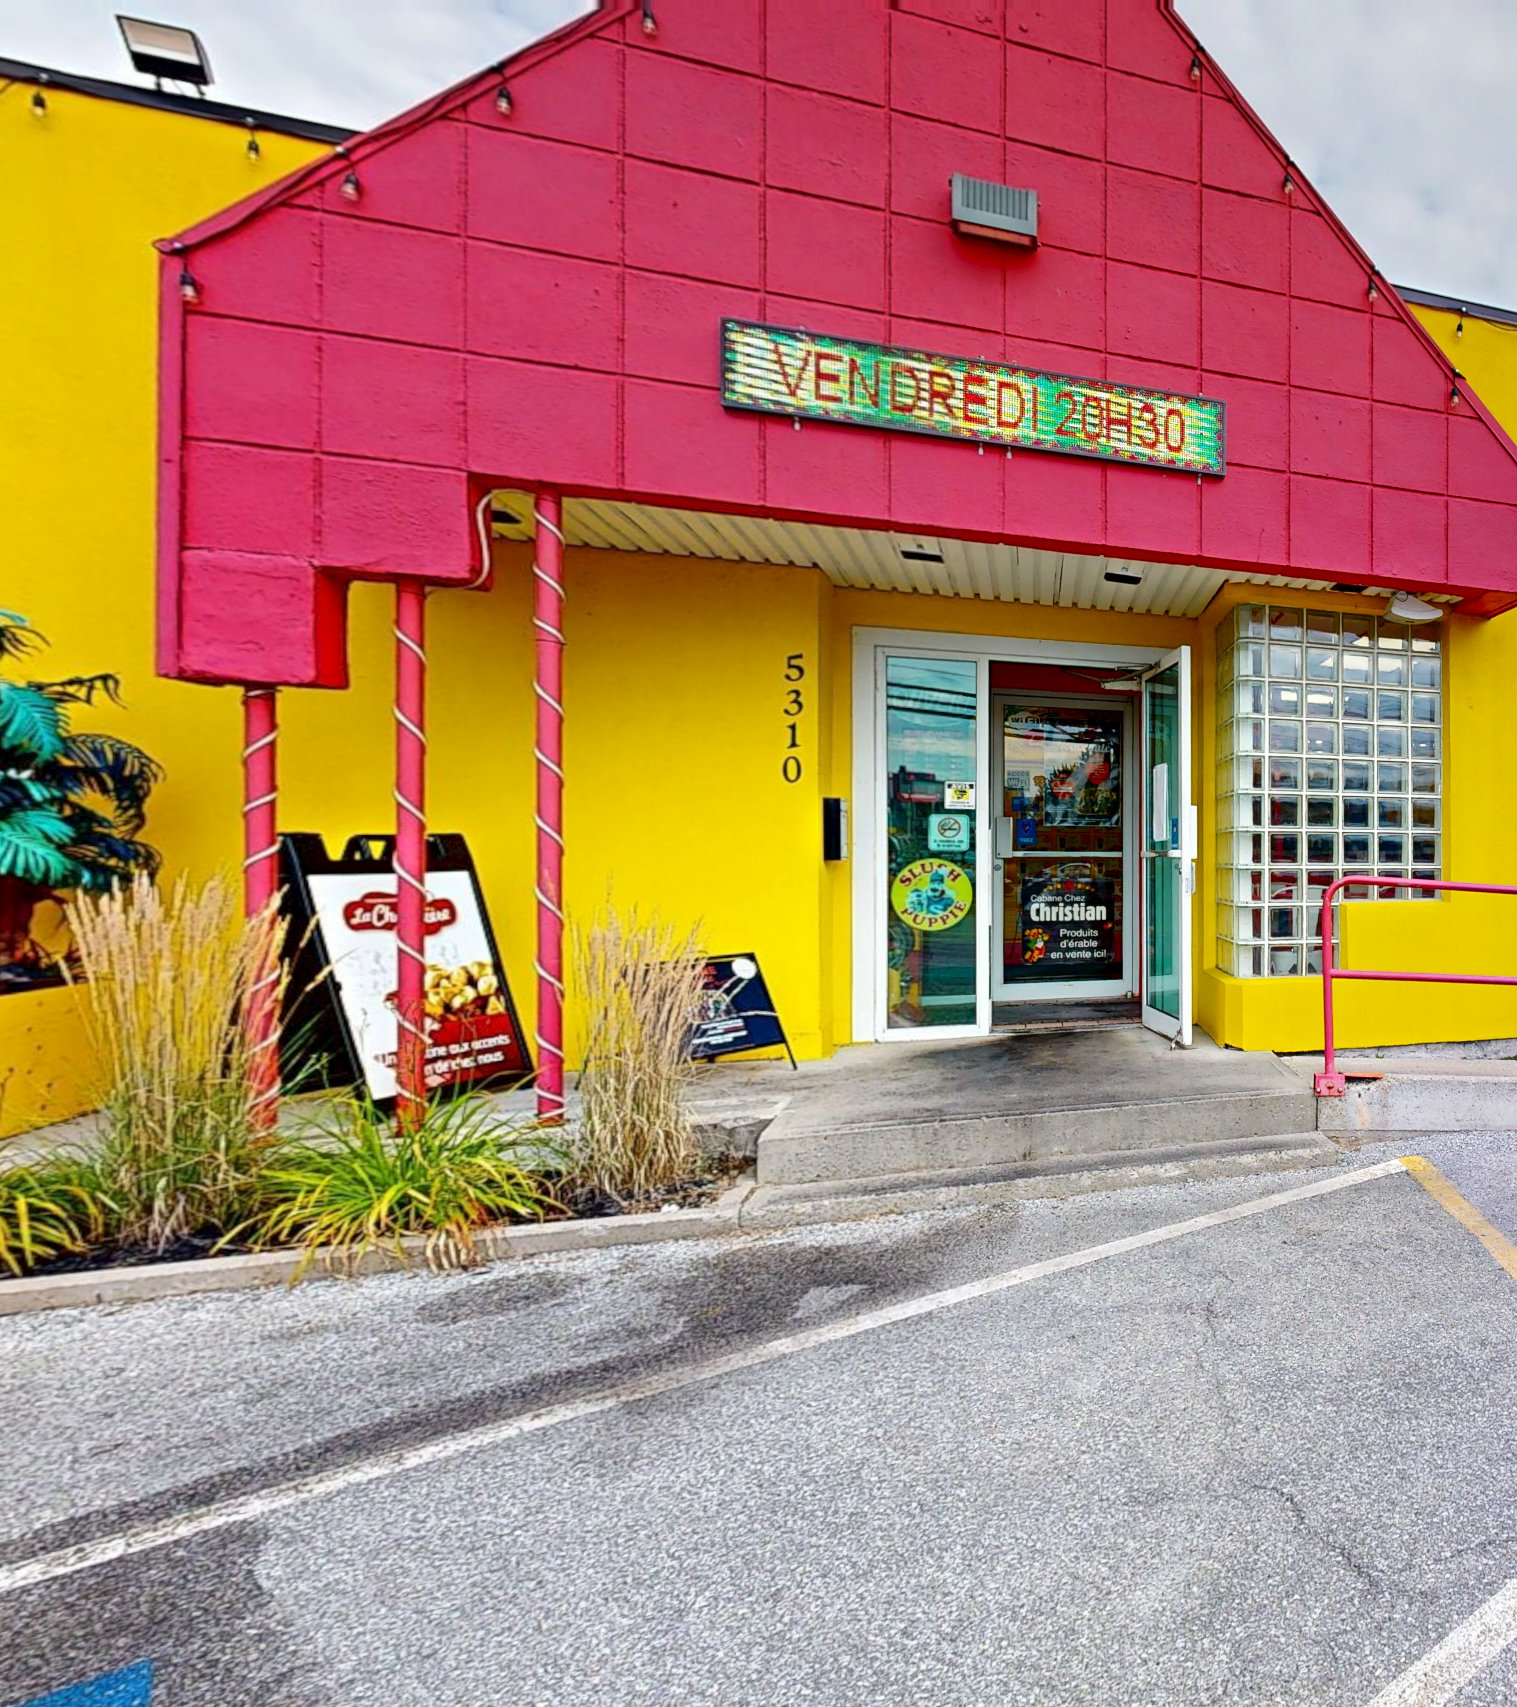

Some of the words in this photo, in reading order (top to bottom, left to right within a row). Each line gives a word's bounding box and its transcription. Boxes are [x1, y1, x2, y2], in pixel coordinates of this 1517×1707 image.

[773, 341, 1039, 433] VENDREDI
[1055, 390, 1186, 453] 20H30
[782, 653, 805, 783] 5310
[1030, 893, 1063, 902] Cabane
[1064, 893, 1086, 902] Chez
[900, 900, 967, 928] PUPPIE
[1030, 902, 1107, 922] Christian
[1059, 928, 1099, 937] Produits
[1059, 939, 1098, 948] d'érable
[1050, 951, 1063, 959] en
[1065, 950, 1091, 959] vente
[1093, 949, 1107, 958] ici!
